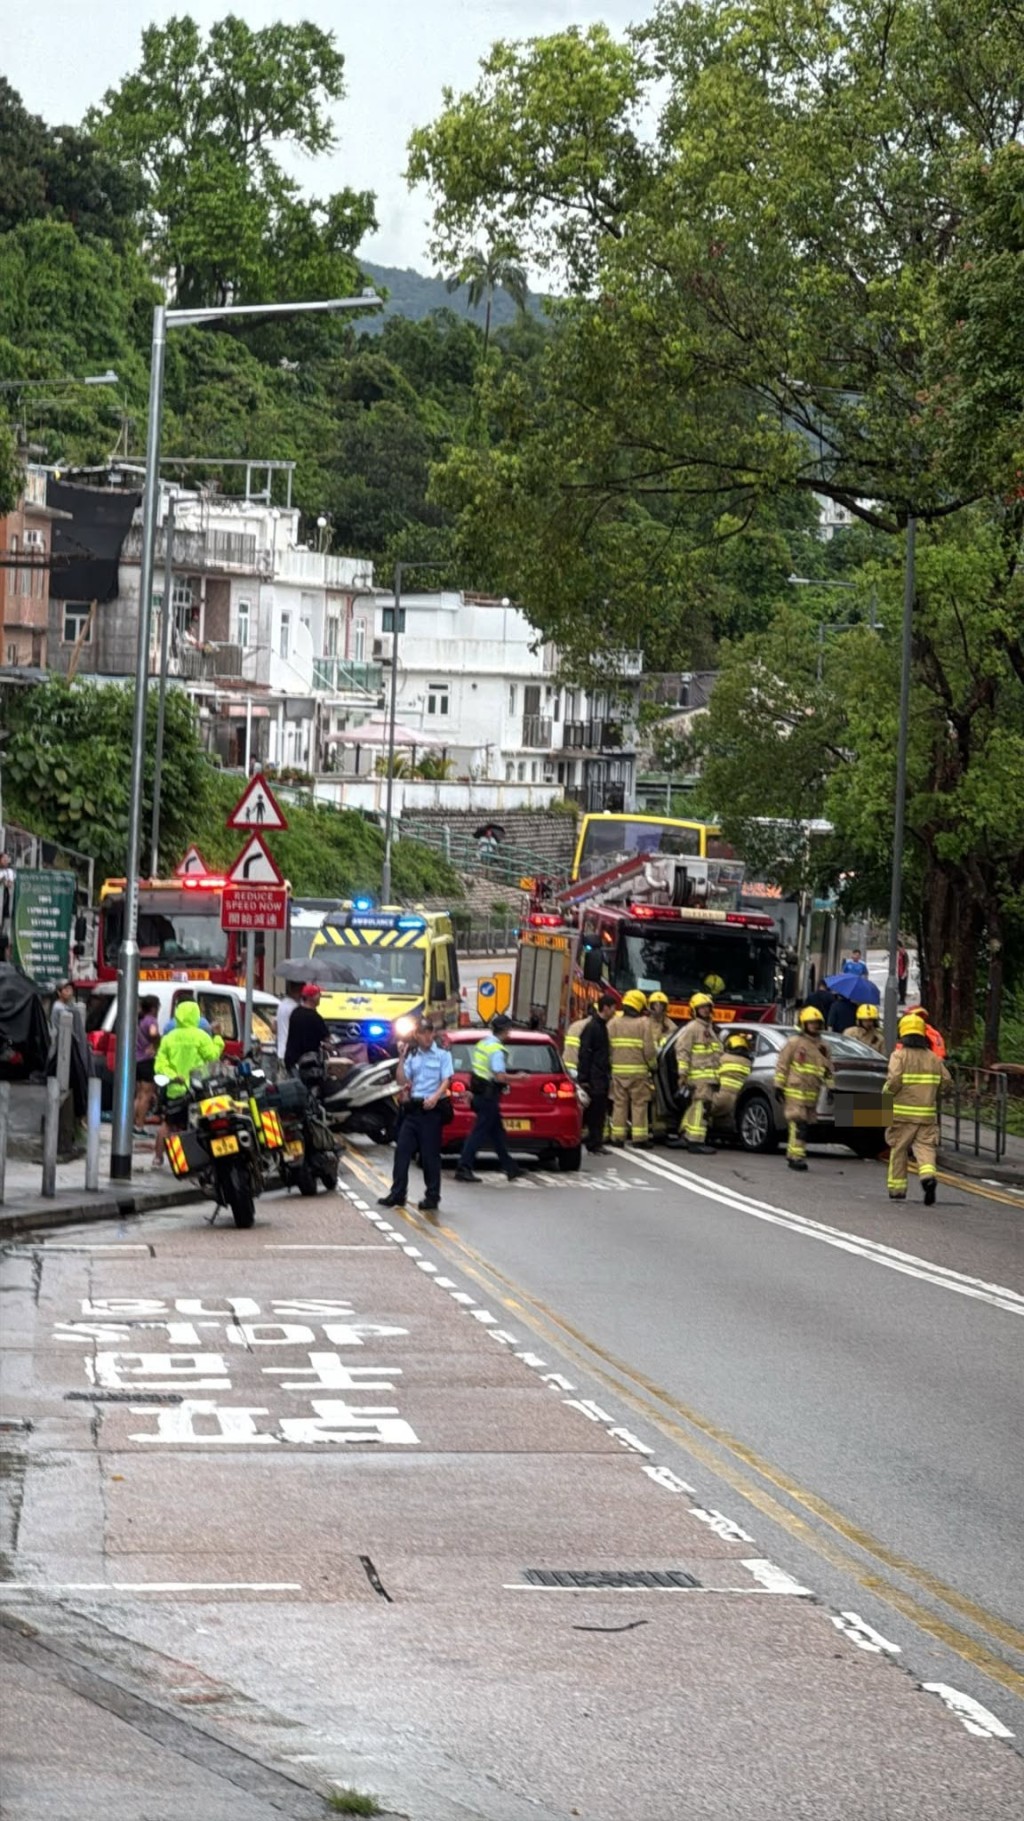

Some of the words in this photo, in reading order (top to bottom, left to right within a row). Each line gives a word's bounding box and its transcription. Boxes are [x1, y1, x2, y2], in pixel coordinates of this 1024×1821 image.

[233, 891, 274, 900] REDUCE
[225, 900, 257, 910] SPEED
[259, 902, 282, 911] NOW
[351, 917, 395, 927] AMBULANCE
[81, 1297, 356, 1316] BUS
[52, 1321, 410, 1345] STOP
[85, 1352, 403, 1390] 巴士
